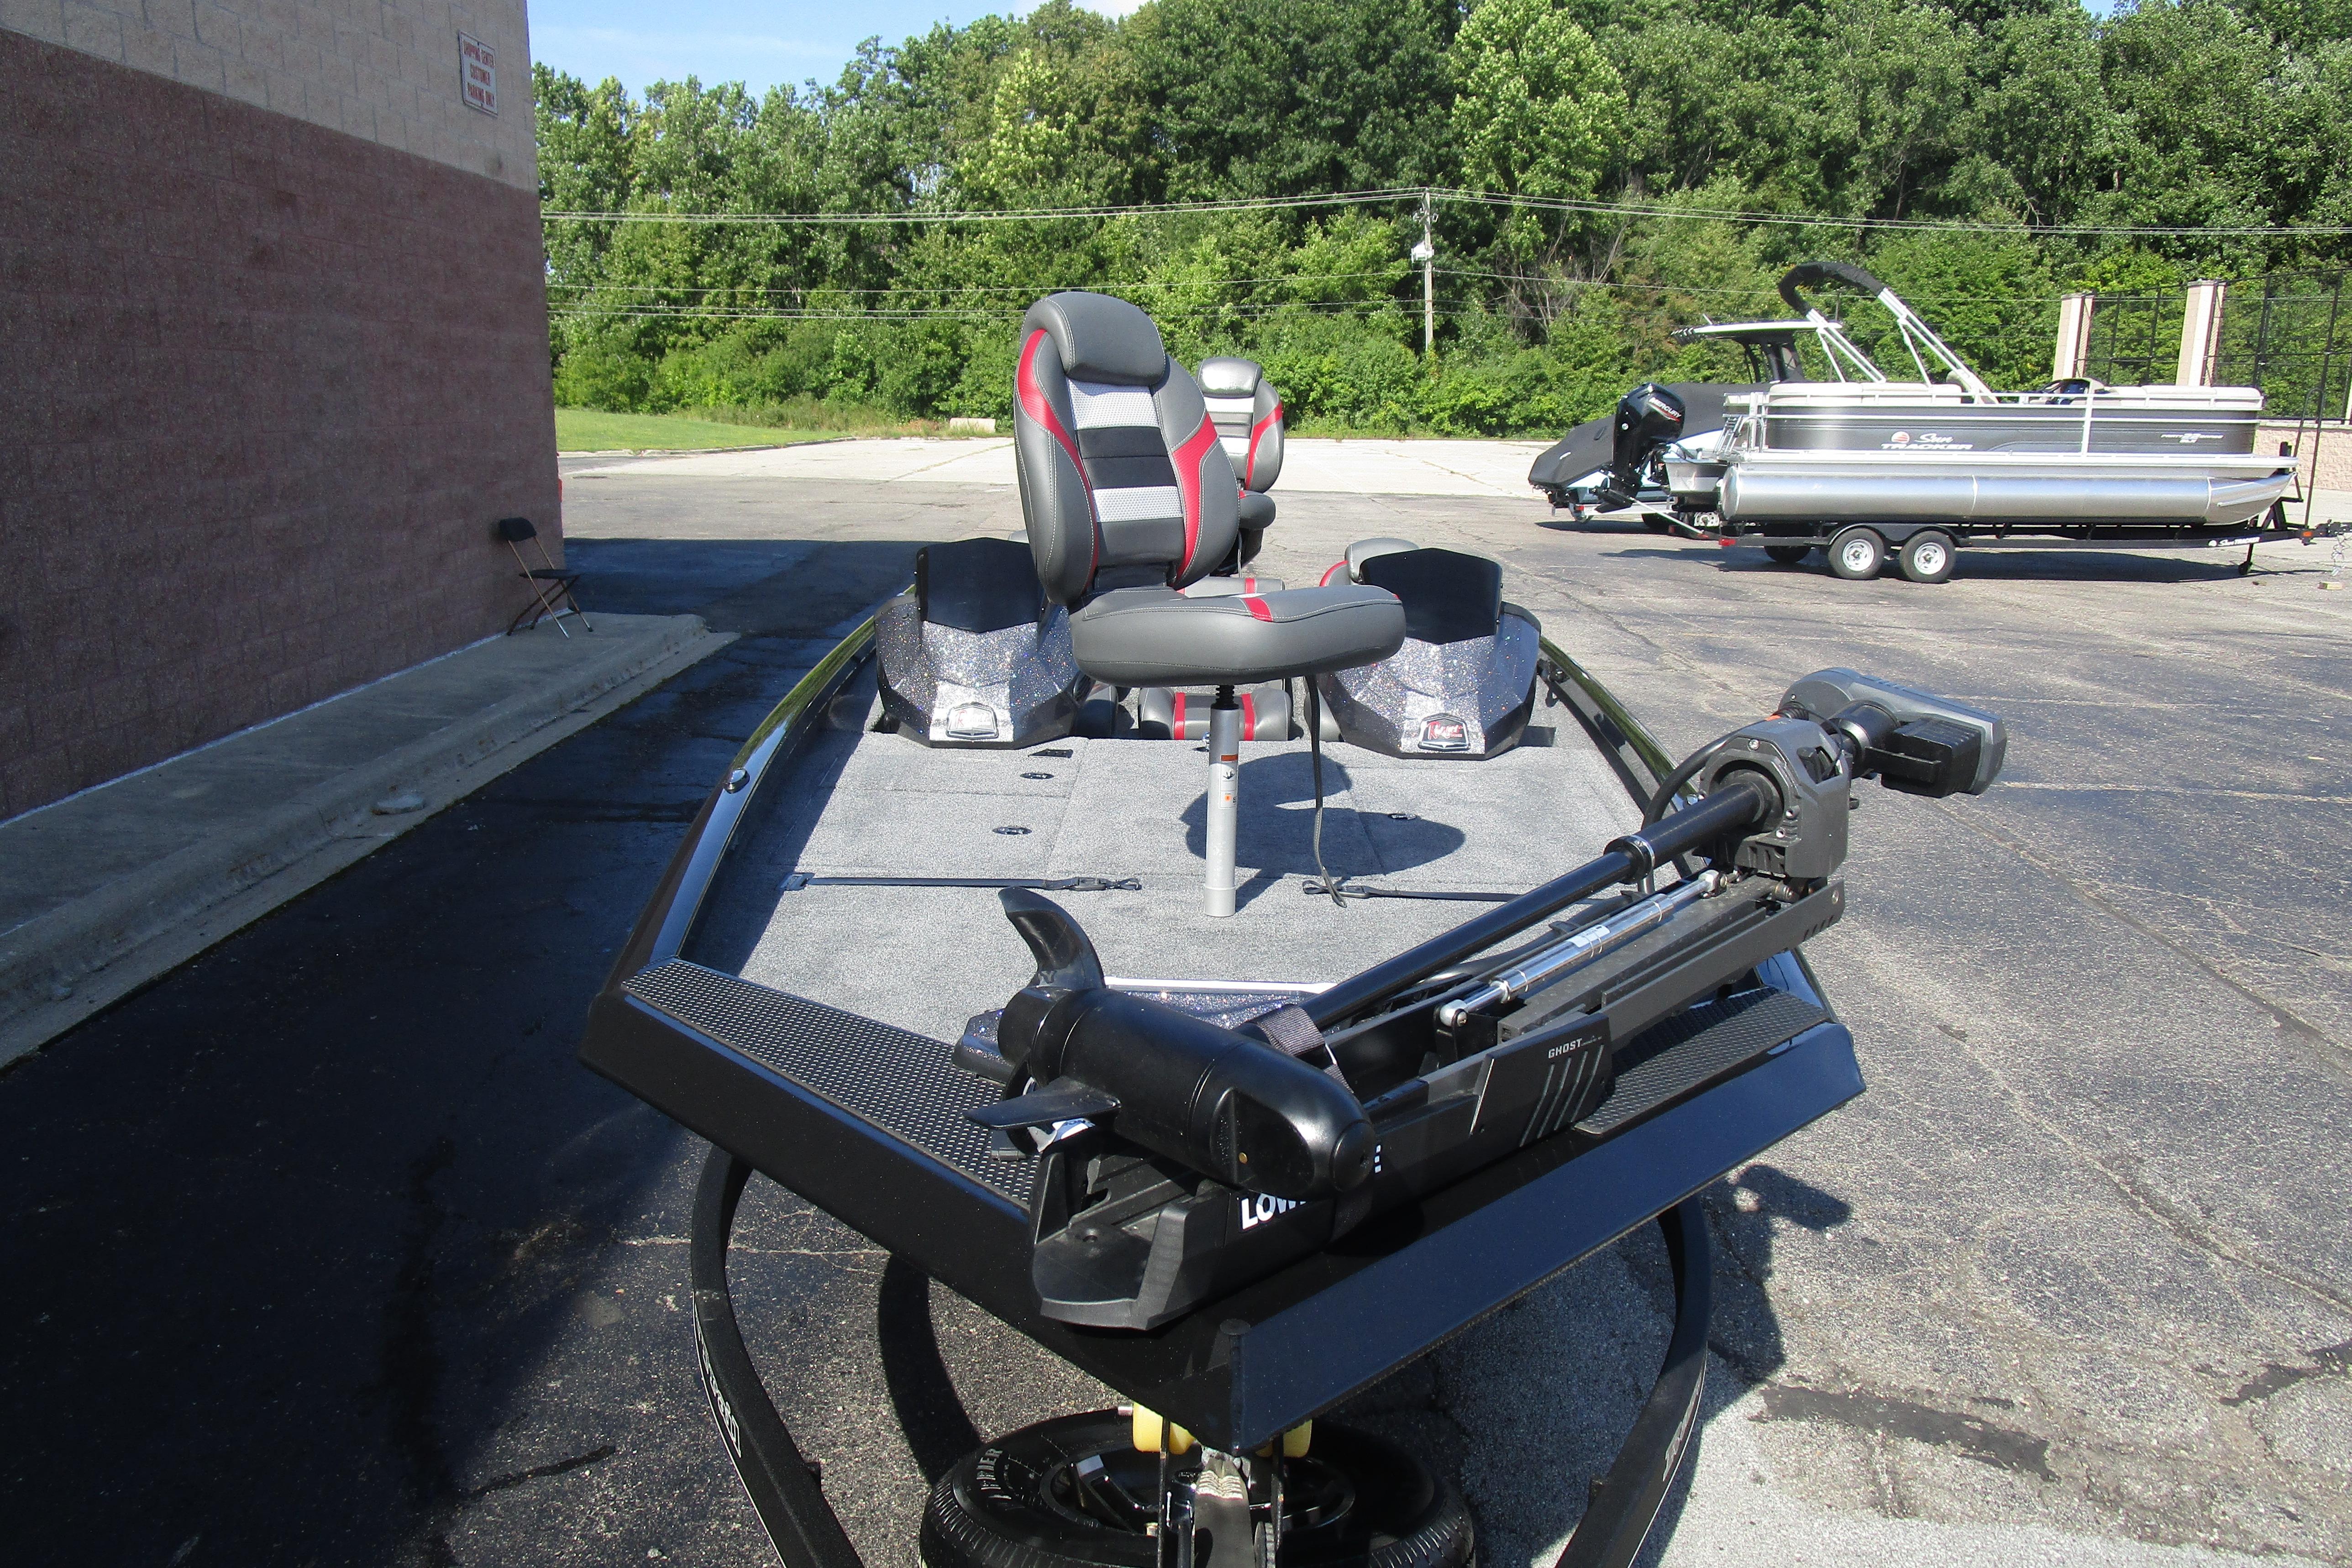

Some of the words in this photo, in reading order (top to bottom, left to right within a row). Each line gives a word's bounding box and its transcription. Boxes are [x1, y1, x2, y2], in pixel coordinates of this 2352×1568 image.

[470, 63, 491, 87] CUSTOMER
[467, 82, 484, 103] PARKING
[1648, 397, 1682, 418] MERCURY
[1914, 433, 1954, 443] Sun
[1548, 1038, 1583, 1059] GHOST
